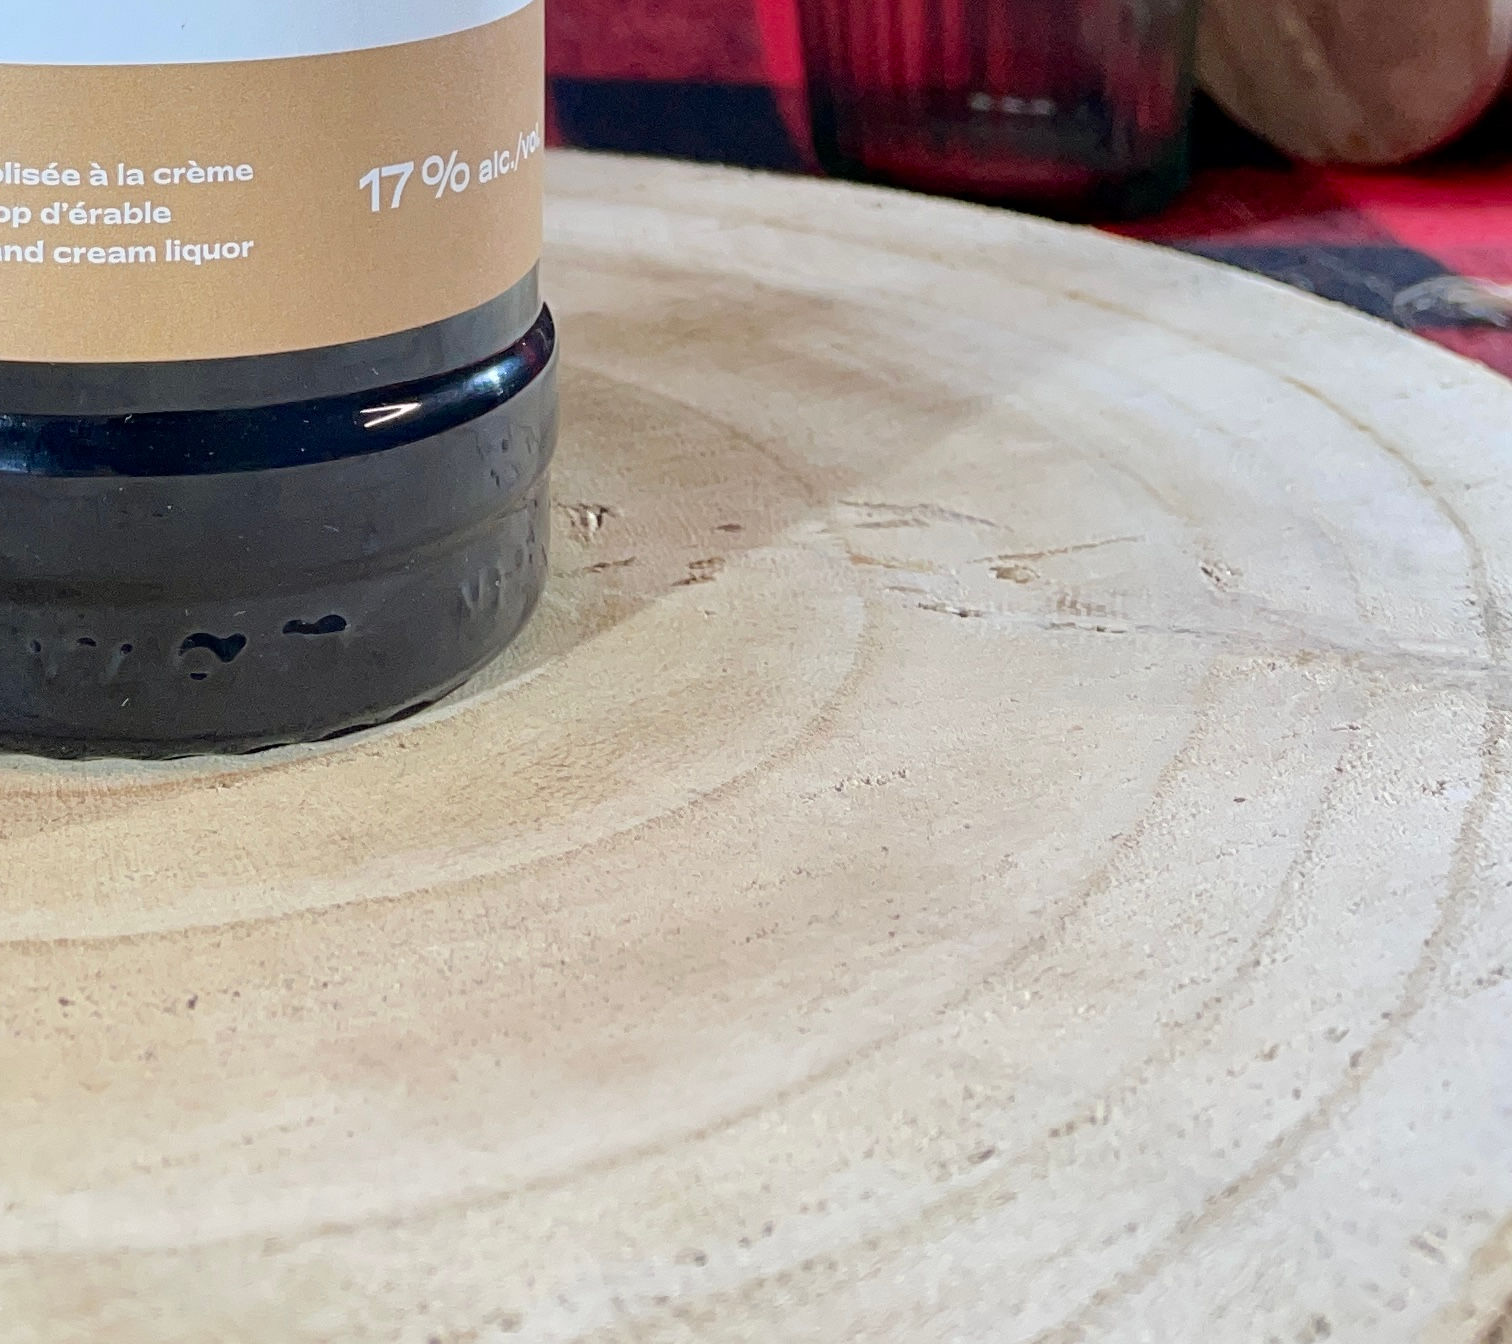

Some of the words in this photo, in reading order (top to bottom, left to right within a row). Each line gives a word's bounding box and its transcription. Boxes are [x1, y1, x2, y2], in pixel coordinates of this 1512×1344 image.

[89, 162, 109, 186] à
[117, 162, 145, 186] la
[153, 160, 254, 185] crème
[53, 245, 157, 264] cream
[165, 239, 254, 266] liquor
